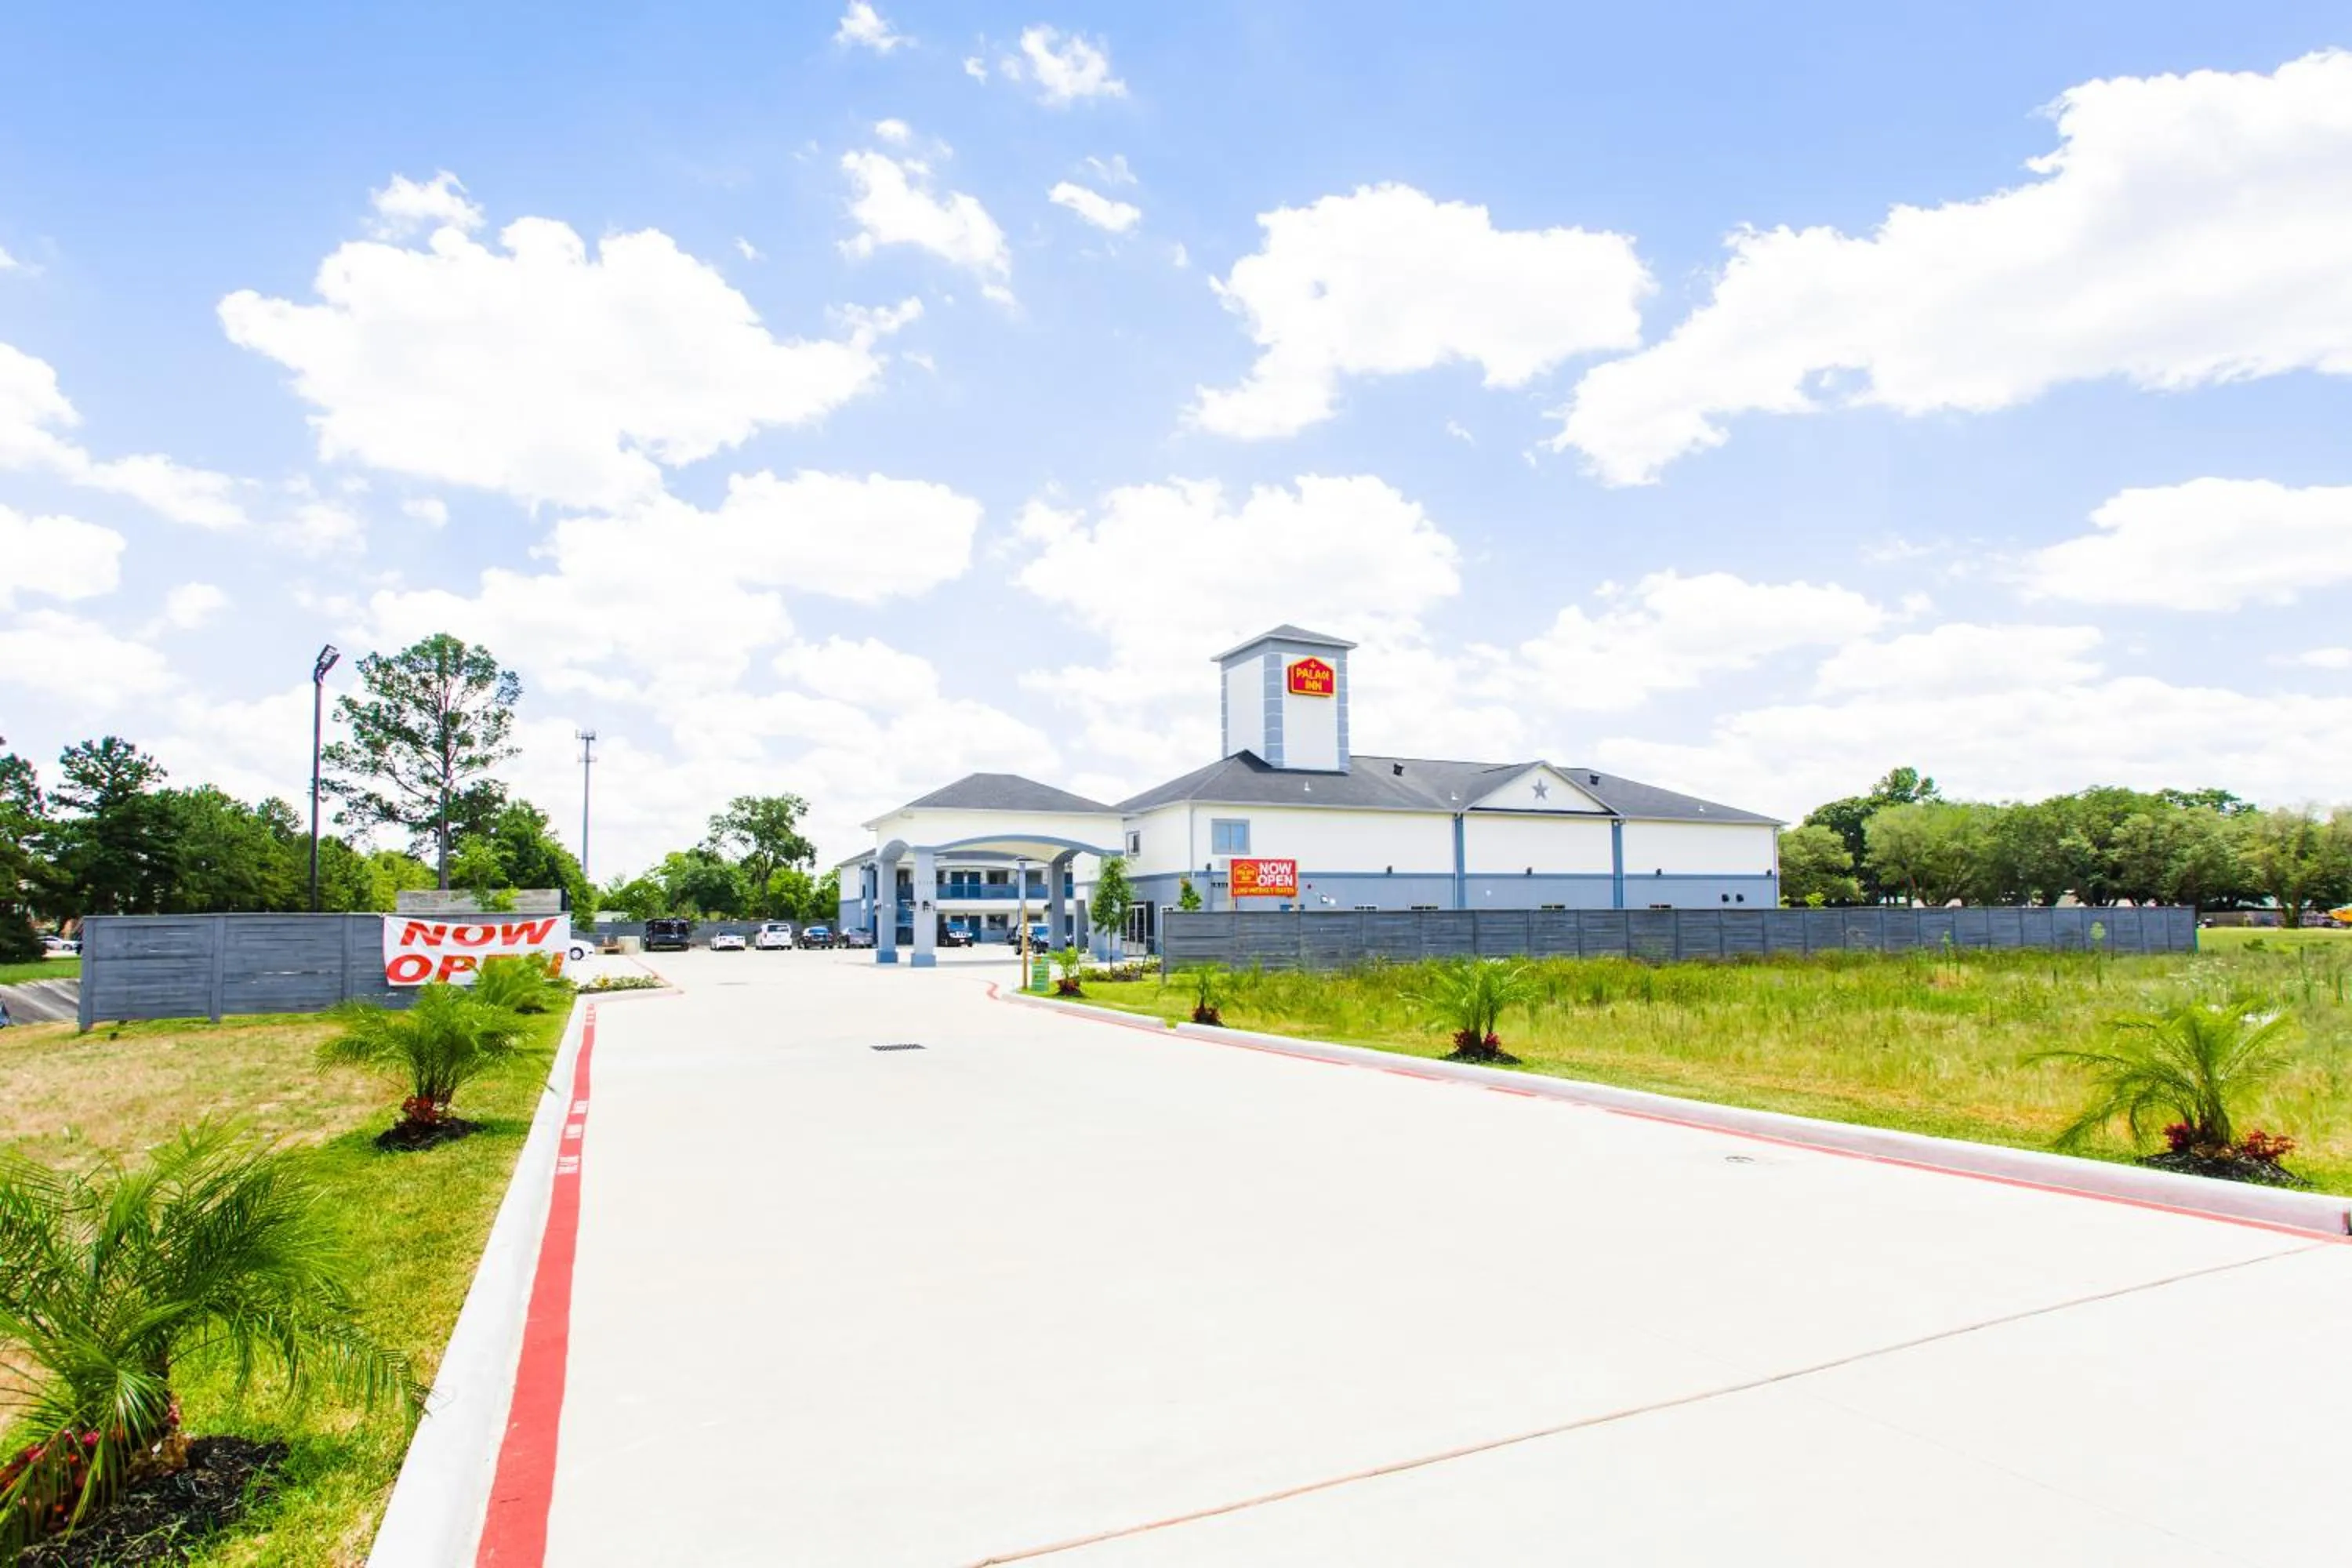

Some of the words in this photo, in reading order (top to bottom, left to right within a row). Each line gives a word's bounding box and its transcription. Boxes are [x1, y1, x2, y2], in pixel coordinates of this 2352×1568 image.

[1259, 862, 1292, 875] NOW
[1257, 874, 1293, 887] OPEN
[400, 918, 557, 946] NOW
[387, 952, 565, 982] OPN
